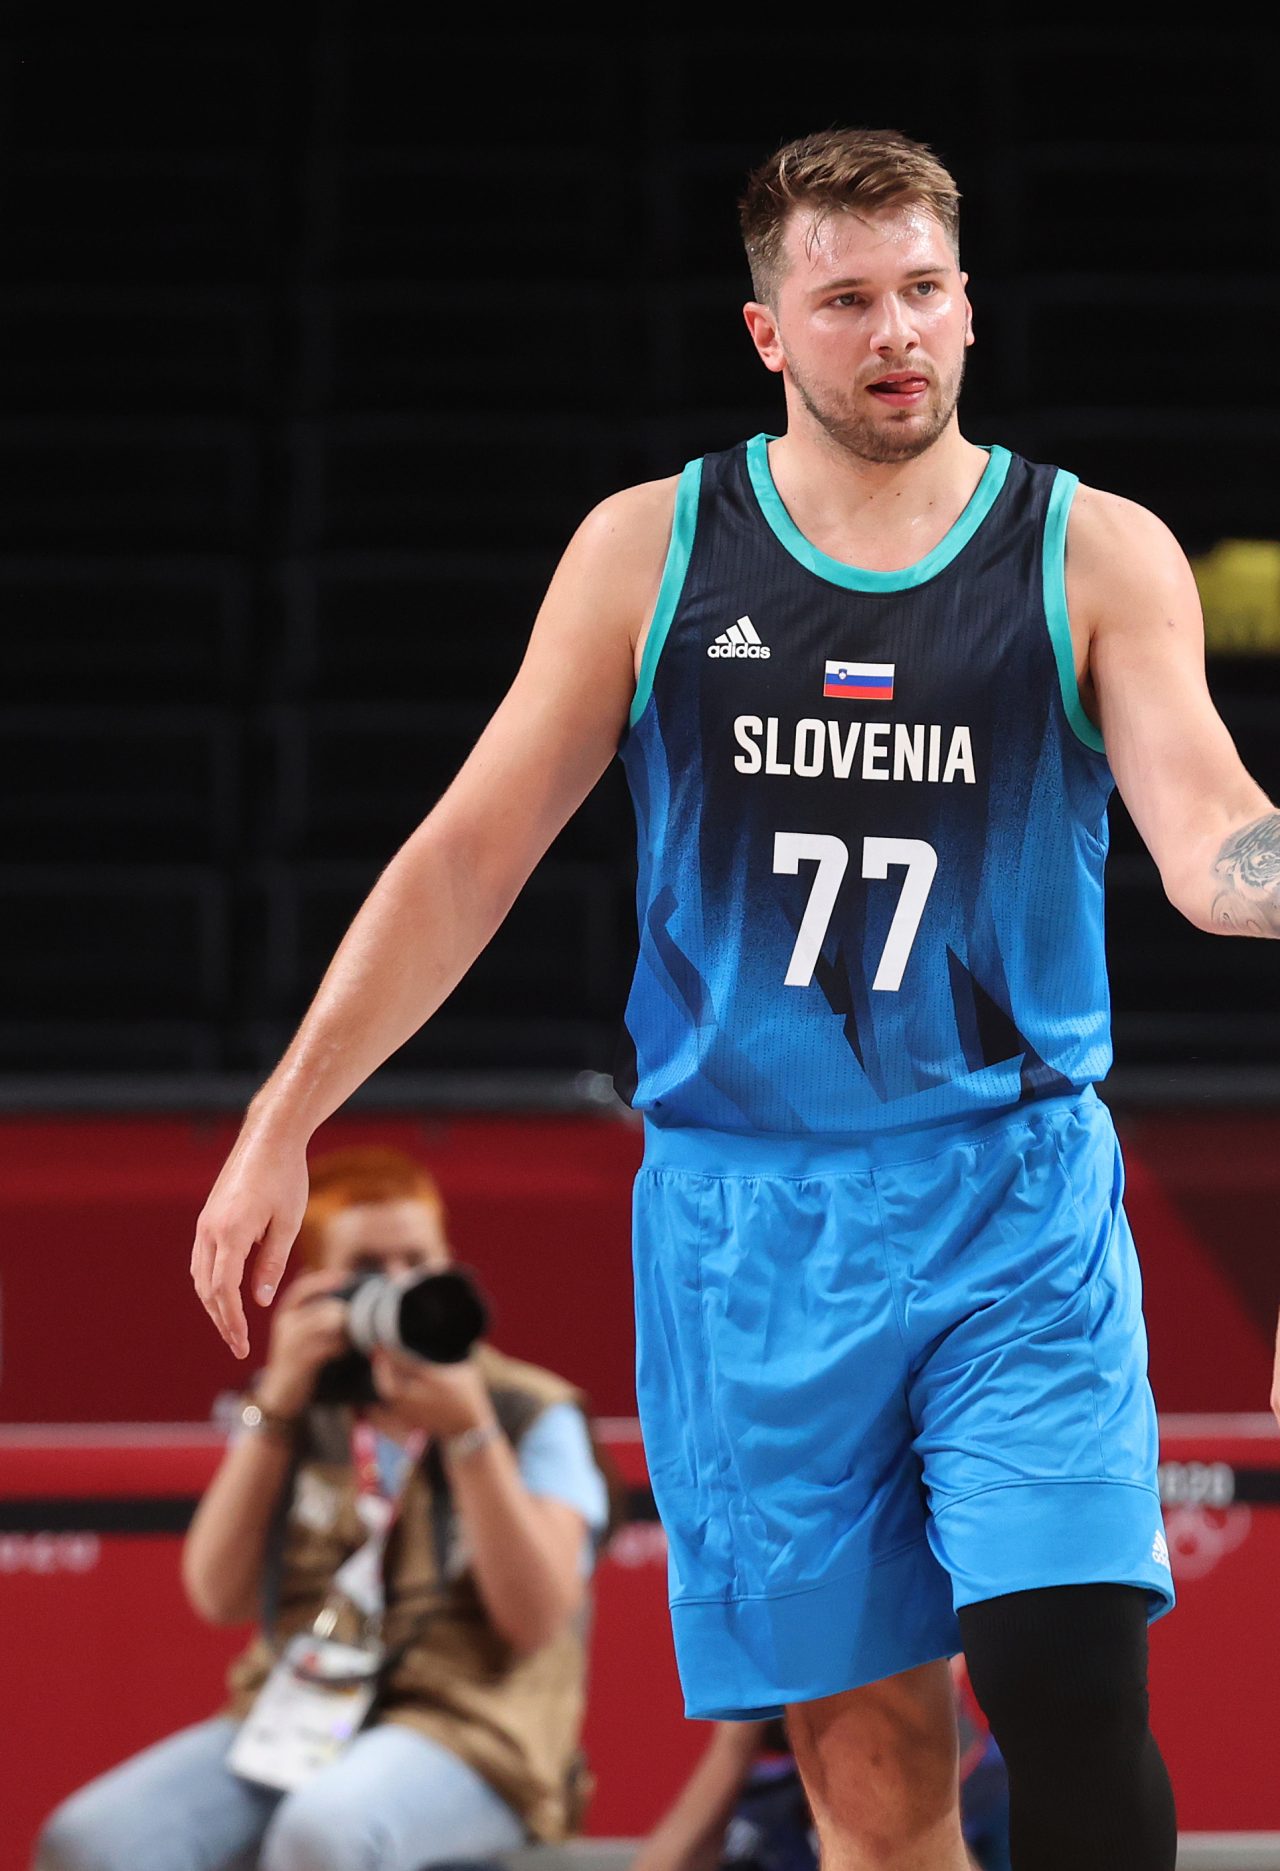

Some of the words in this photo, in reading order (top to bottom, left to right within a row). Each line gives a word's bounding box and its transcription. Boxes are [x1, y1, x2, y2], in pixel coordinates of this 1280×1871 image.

[707, 642, 771, 659] adidas
[733, 715, 976, 783] SLOVENIA
[772, 832, 938, 991] 77
